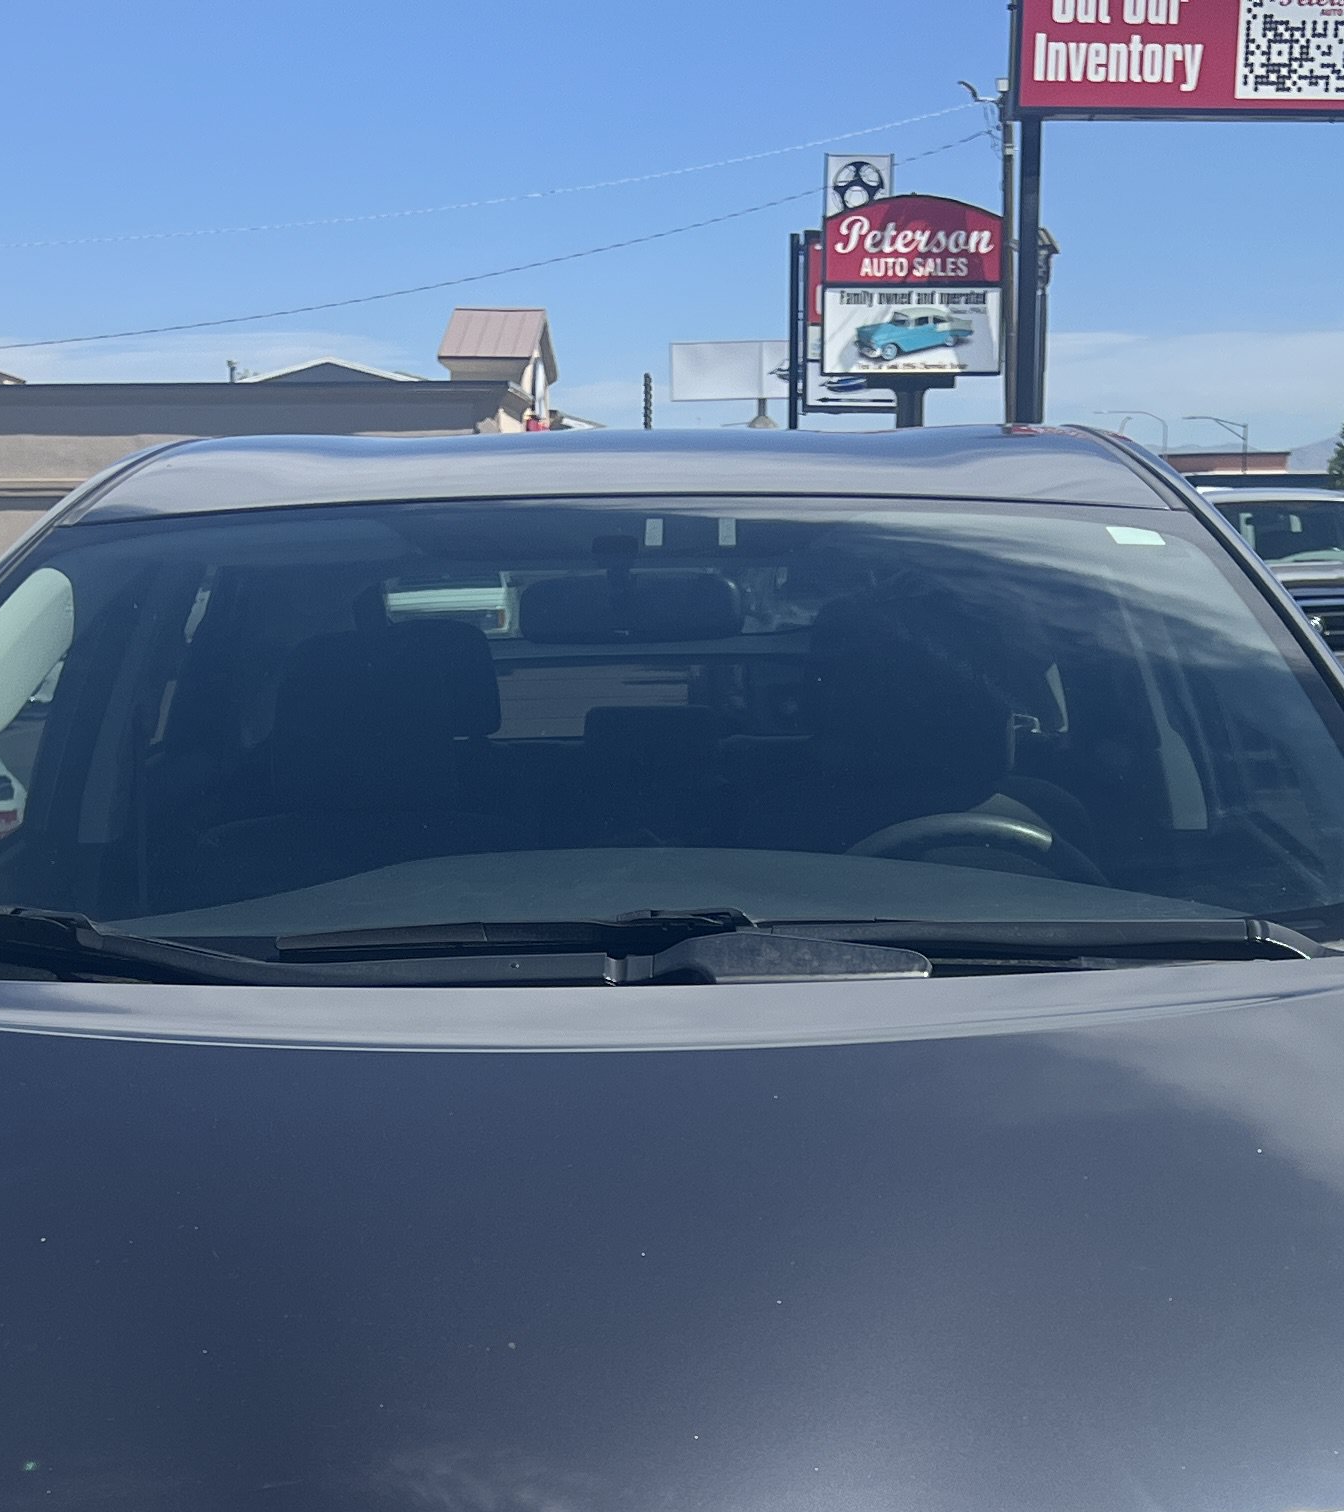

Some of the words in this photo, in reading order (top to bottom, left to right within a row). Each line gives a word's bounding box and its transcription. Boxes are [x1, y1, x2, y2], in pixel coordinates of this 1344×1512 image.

[1033, 32, 1204, 92] Inventory
[834, 215, 994, 254] Peterson
[860, 258, 908, 277] AUTO
[912, 258, 969, 277] SALES
